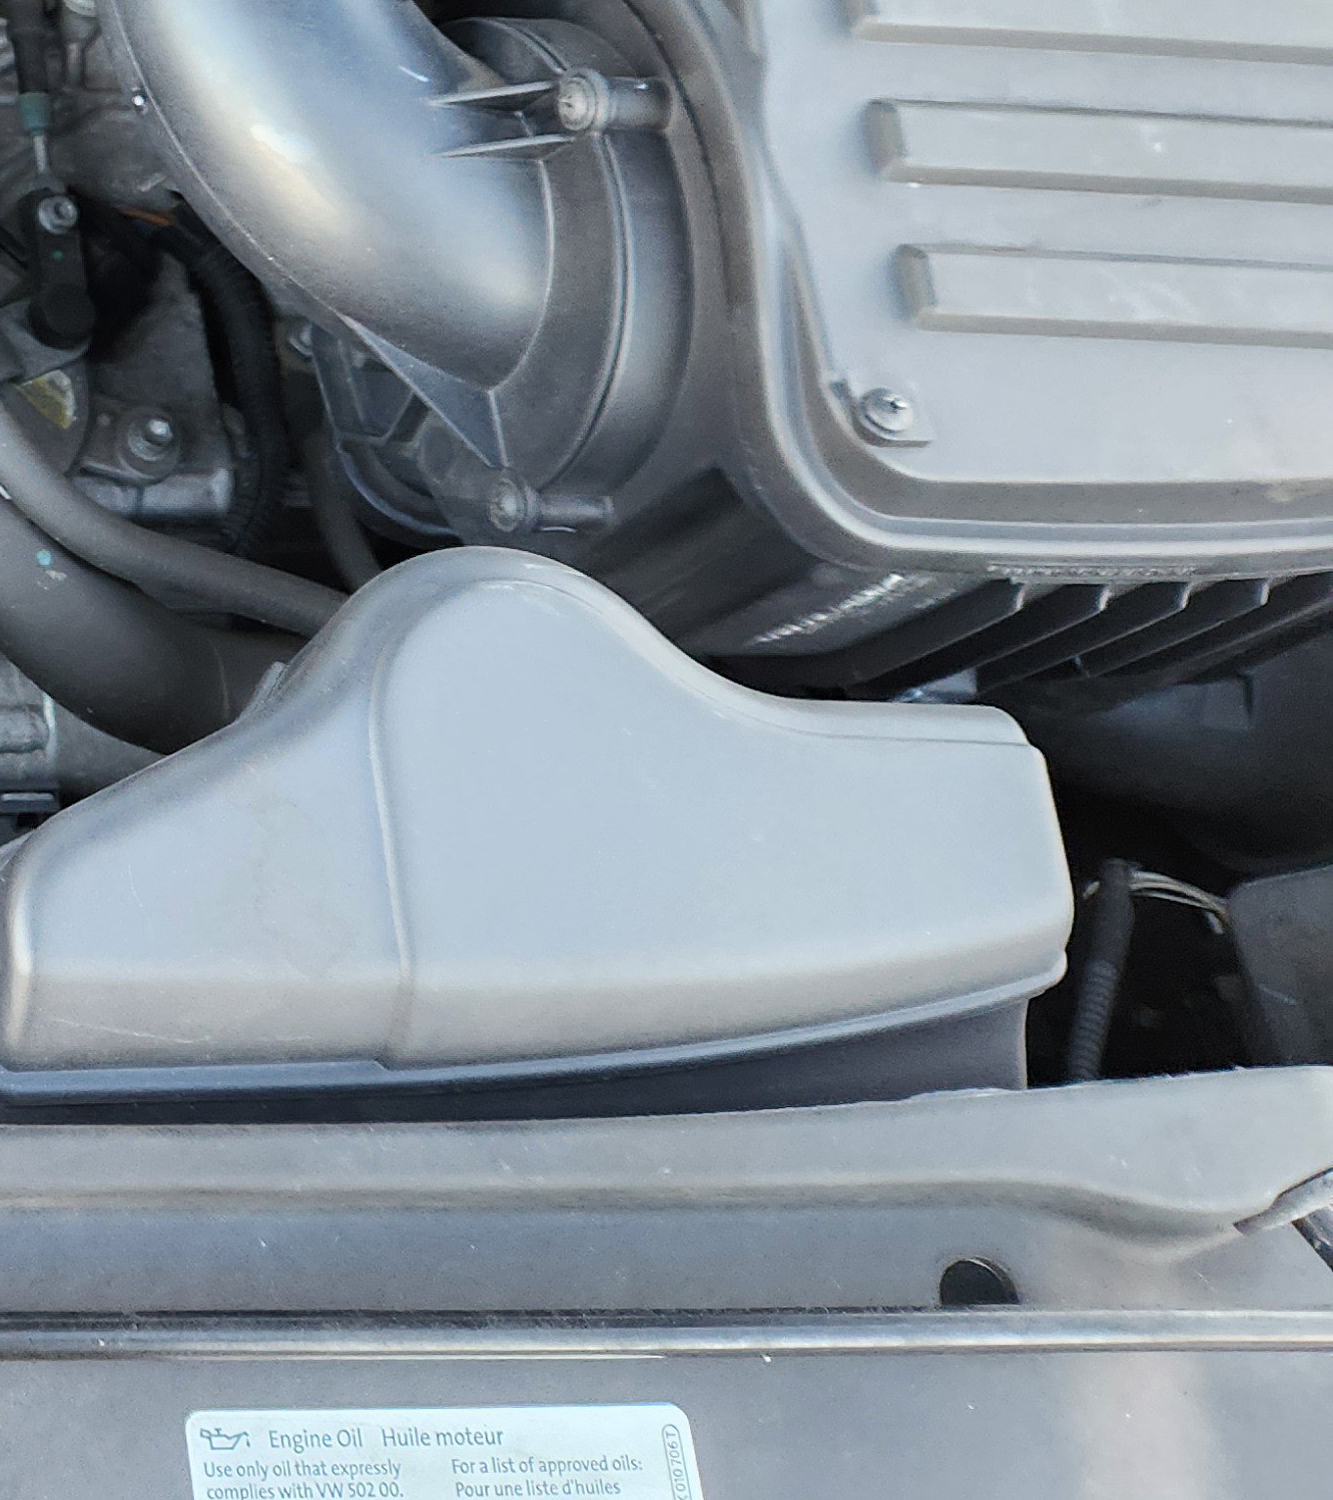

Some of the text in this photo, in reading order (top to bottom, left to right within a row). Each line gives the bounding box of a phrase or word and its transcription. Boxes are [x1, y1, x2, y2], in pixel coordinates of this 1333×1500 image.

[269, 1427, 363, 1454] Engine Oil
[381, 1428, 504, 1449] Huile moteur
[665, 1430, 676, 1438] T
[667, 1441, 682, 1466] 706
[203, 1458, 402, 1483] Use only oil that expressly
[451, 1454, 644, 1479] For a list of approved oils:
[207, 1481, 405, 1500] complies with VW 502 00.
[455, 1479, 622, 1498] Pour une liste d'huiles
[673, 1468, 686, 1492] 010
